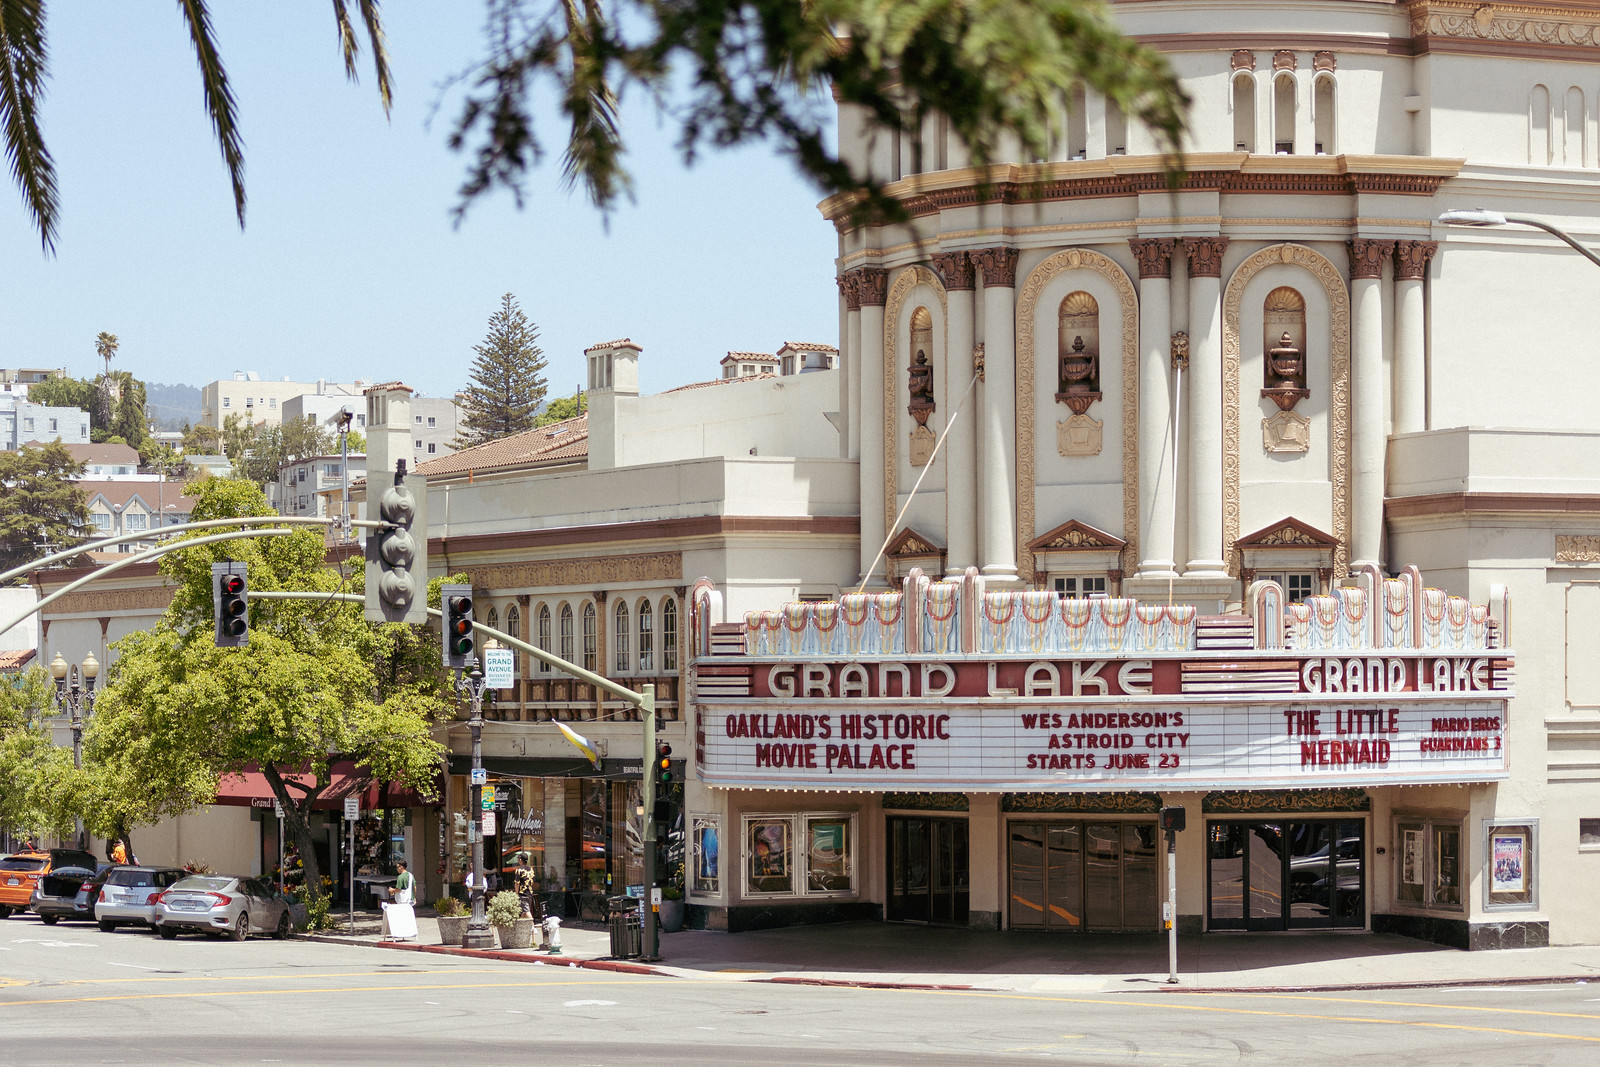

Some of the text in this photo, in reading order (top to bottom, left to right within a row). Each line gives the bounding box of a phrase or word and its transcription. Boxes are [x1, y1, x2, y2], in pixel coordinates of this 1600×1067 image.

[768, 660, 1154, 698] GRAND LAKE
[1303, 657, 1490, 693] GRAND LAKE
[726, 713, 832, 740] OAKLAND'S
[840, 713, 951, 740] HISTORIC
[1022, 712, 1185, 730] WES ANDERSON'S
[1284, 708, 1400, 736] THE LITTLE
[1431, 716, 1500, 732] MARIO BROS
[1048, 732, 1190, 749] ASTROID CITY
[1420, 735, 1501, 752] GUARDIANS 3
[756, 743, 916, 770] MOVIE PALACE
[1026, 752, 1181, 770] STARTS JUNE 23
[1301, 739, 1392, 767] MERMAID
[251, 797, 271, 808] Grand
